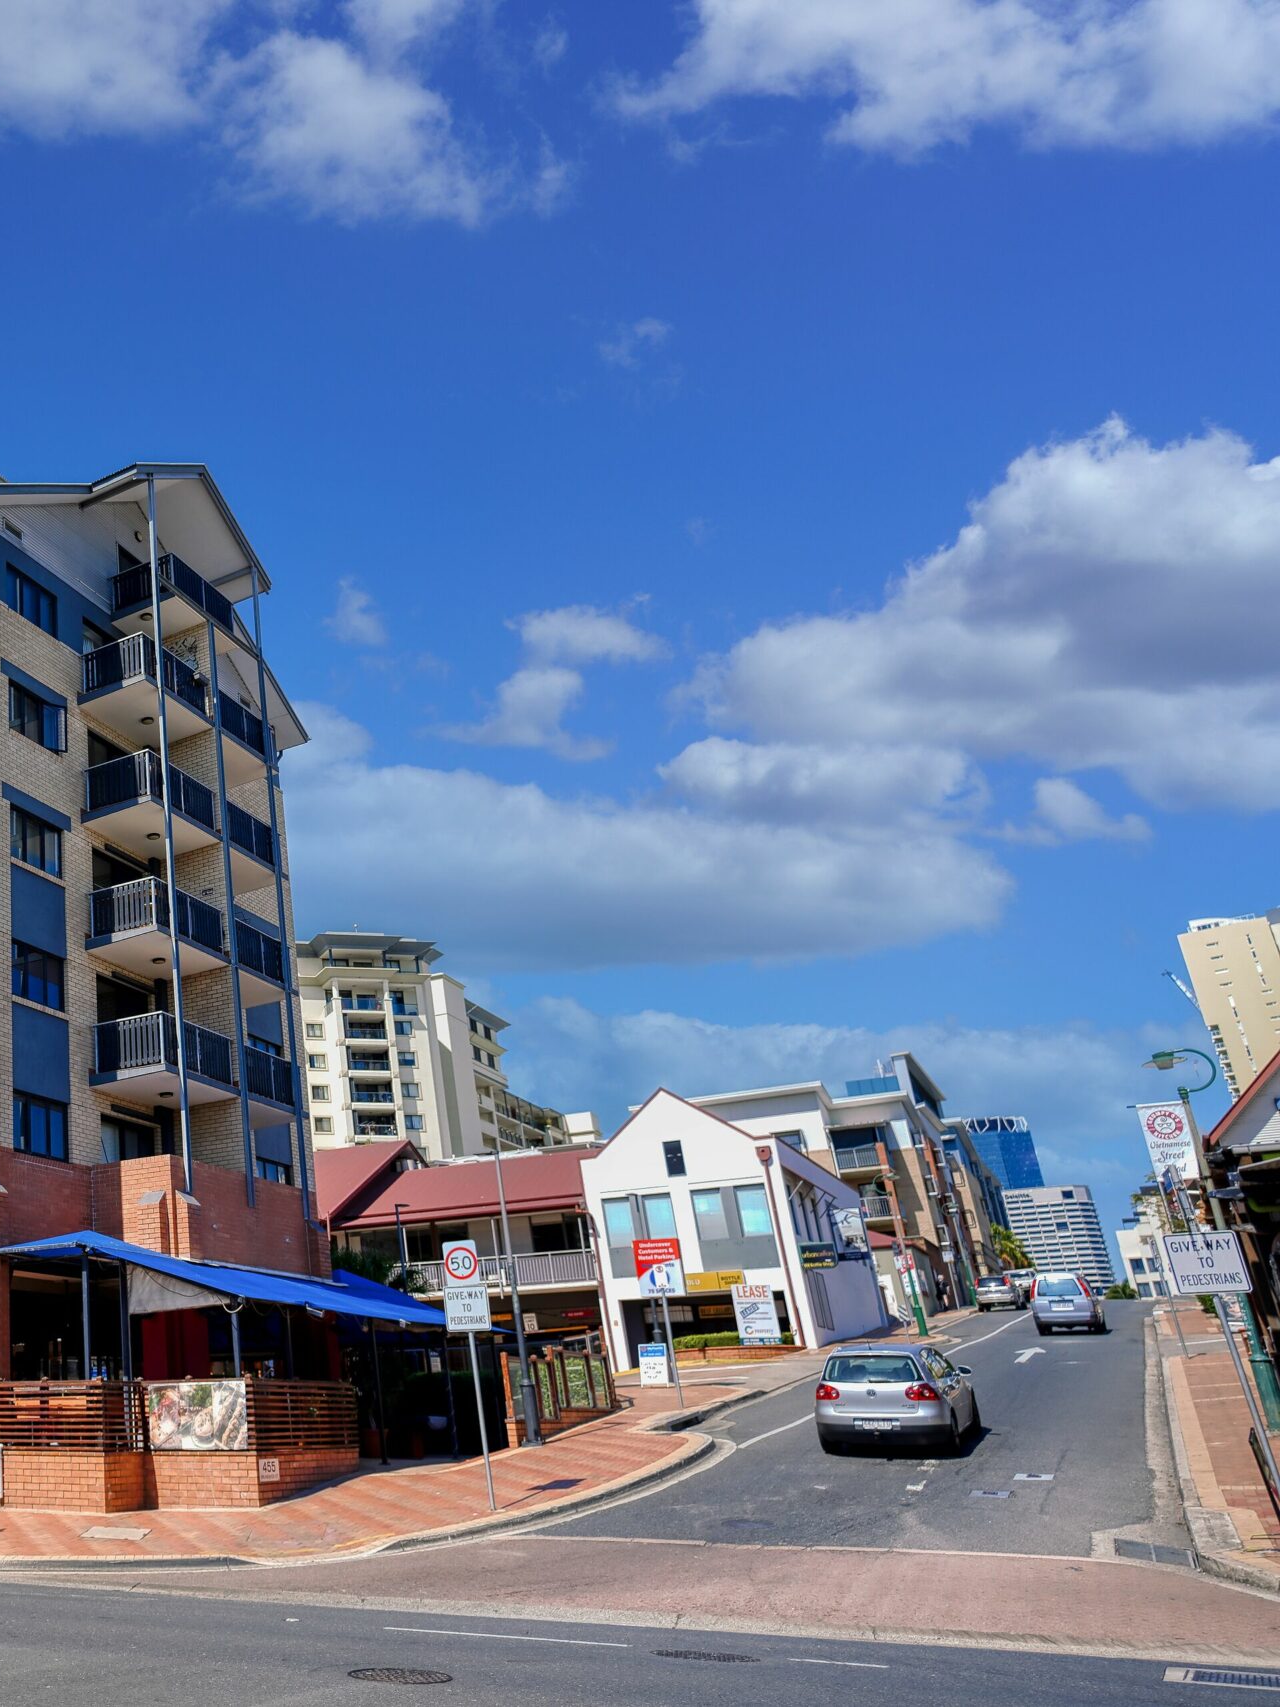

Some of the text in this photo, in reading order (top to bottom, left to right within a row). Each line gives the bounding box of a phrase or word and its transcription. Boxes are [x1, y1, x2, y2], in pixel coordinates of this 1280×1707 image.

[1153, 1130, 1181, 1139] KITCHEN
[1150, 1140, 1191, 1149] Vietnamese
[1157, 1151, 1185, 1163] Street
[1170, 1238, 1231, 1253] GIVE WAY
[450, 1255, 472, 1271] 50
[1197, 1256, 1214, 1268] TO
[1180, 1272, 1243, 1287] PEDESTRIANS
[447, 1290, 484, 1301] GIVE WAY
[736, 1285, 769, 1298] LEASE
[462, 1303, 472, 1312] TO
[449, 1314, 487, 1326] PEDESTRIANS
[262, 1461, 276, 1473] 455
